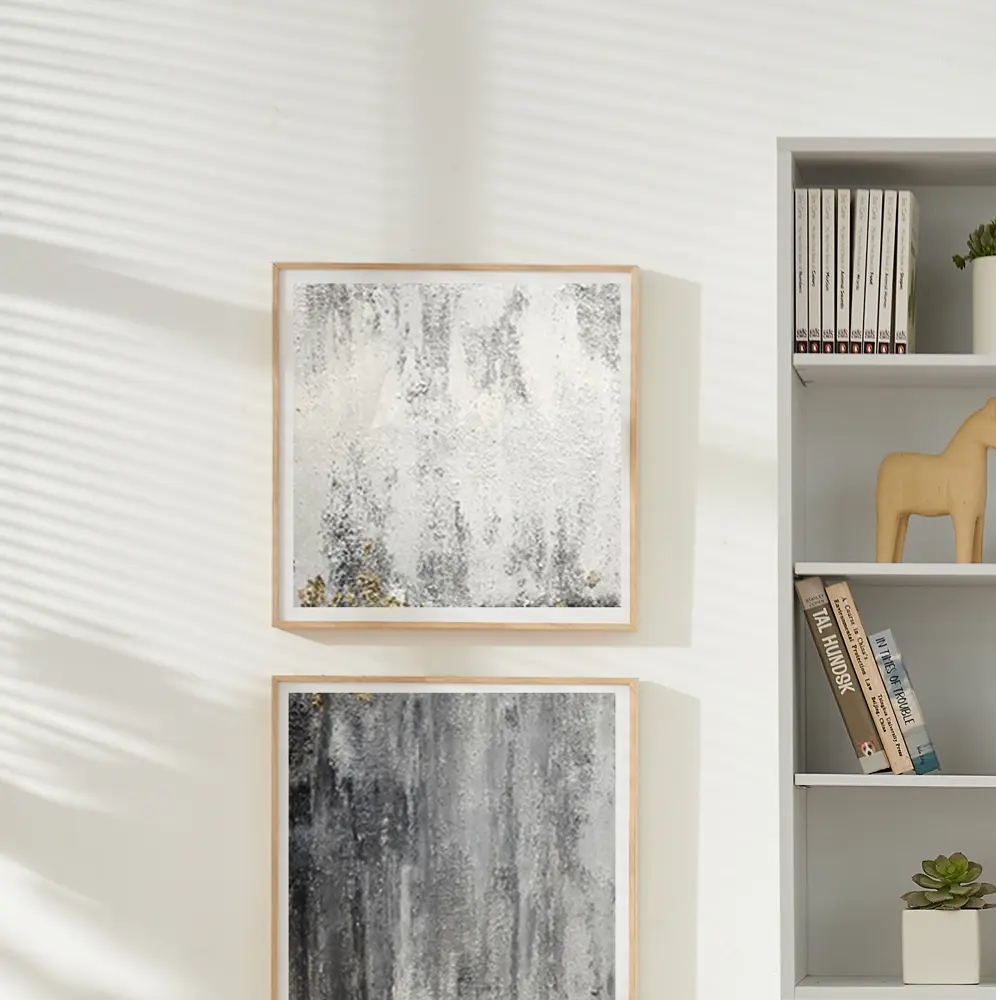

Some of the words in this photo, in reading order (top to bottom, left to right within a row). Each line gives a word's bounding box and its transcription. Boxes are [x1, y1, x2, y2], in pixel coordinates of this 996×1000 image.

[812, 607, 833, 633] TAL
[844, 604, 855, 625] Course
[858, 637, 868, 660] China's
[875, 637, 888, 648] IN
[852, 644, 866, 675] Protection
[865, 678, 873, 691] Law
[879, 648, 896, 675] TIMES
[889, 675, 901, 688] OF
[892, 687, 915, 726] TROUBLE
